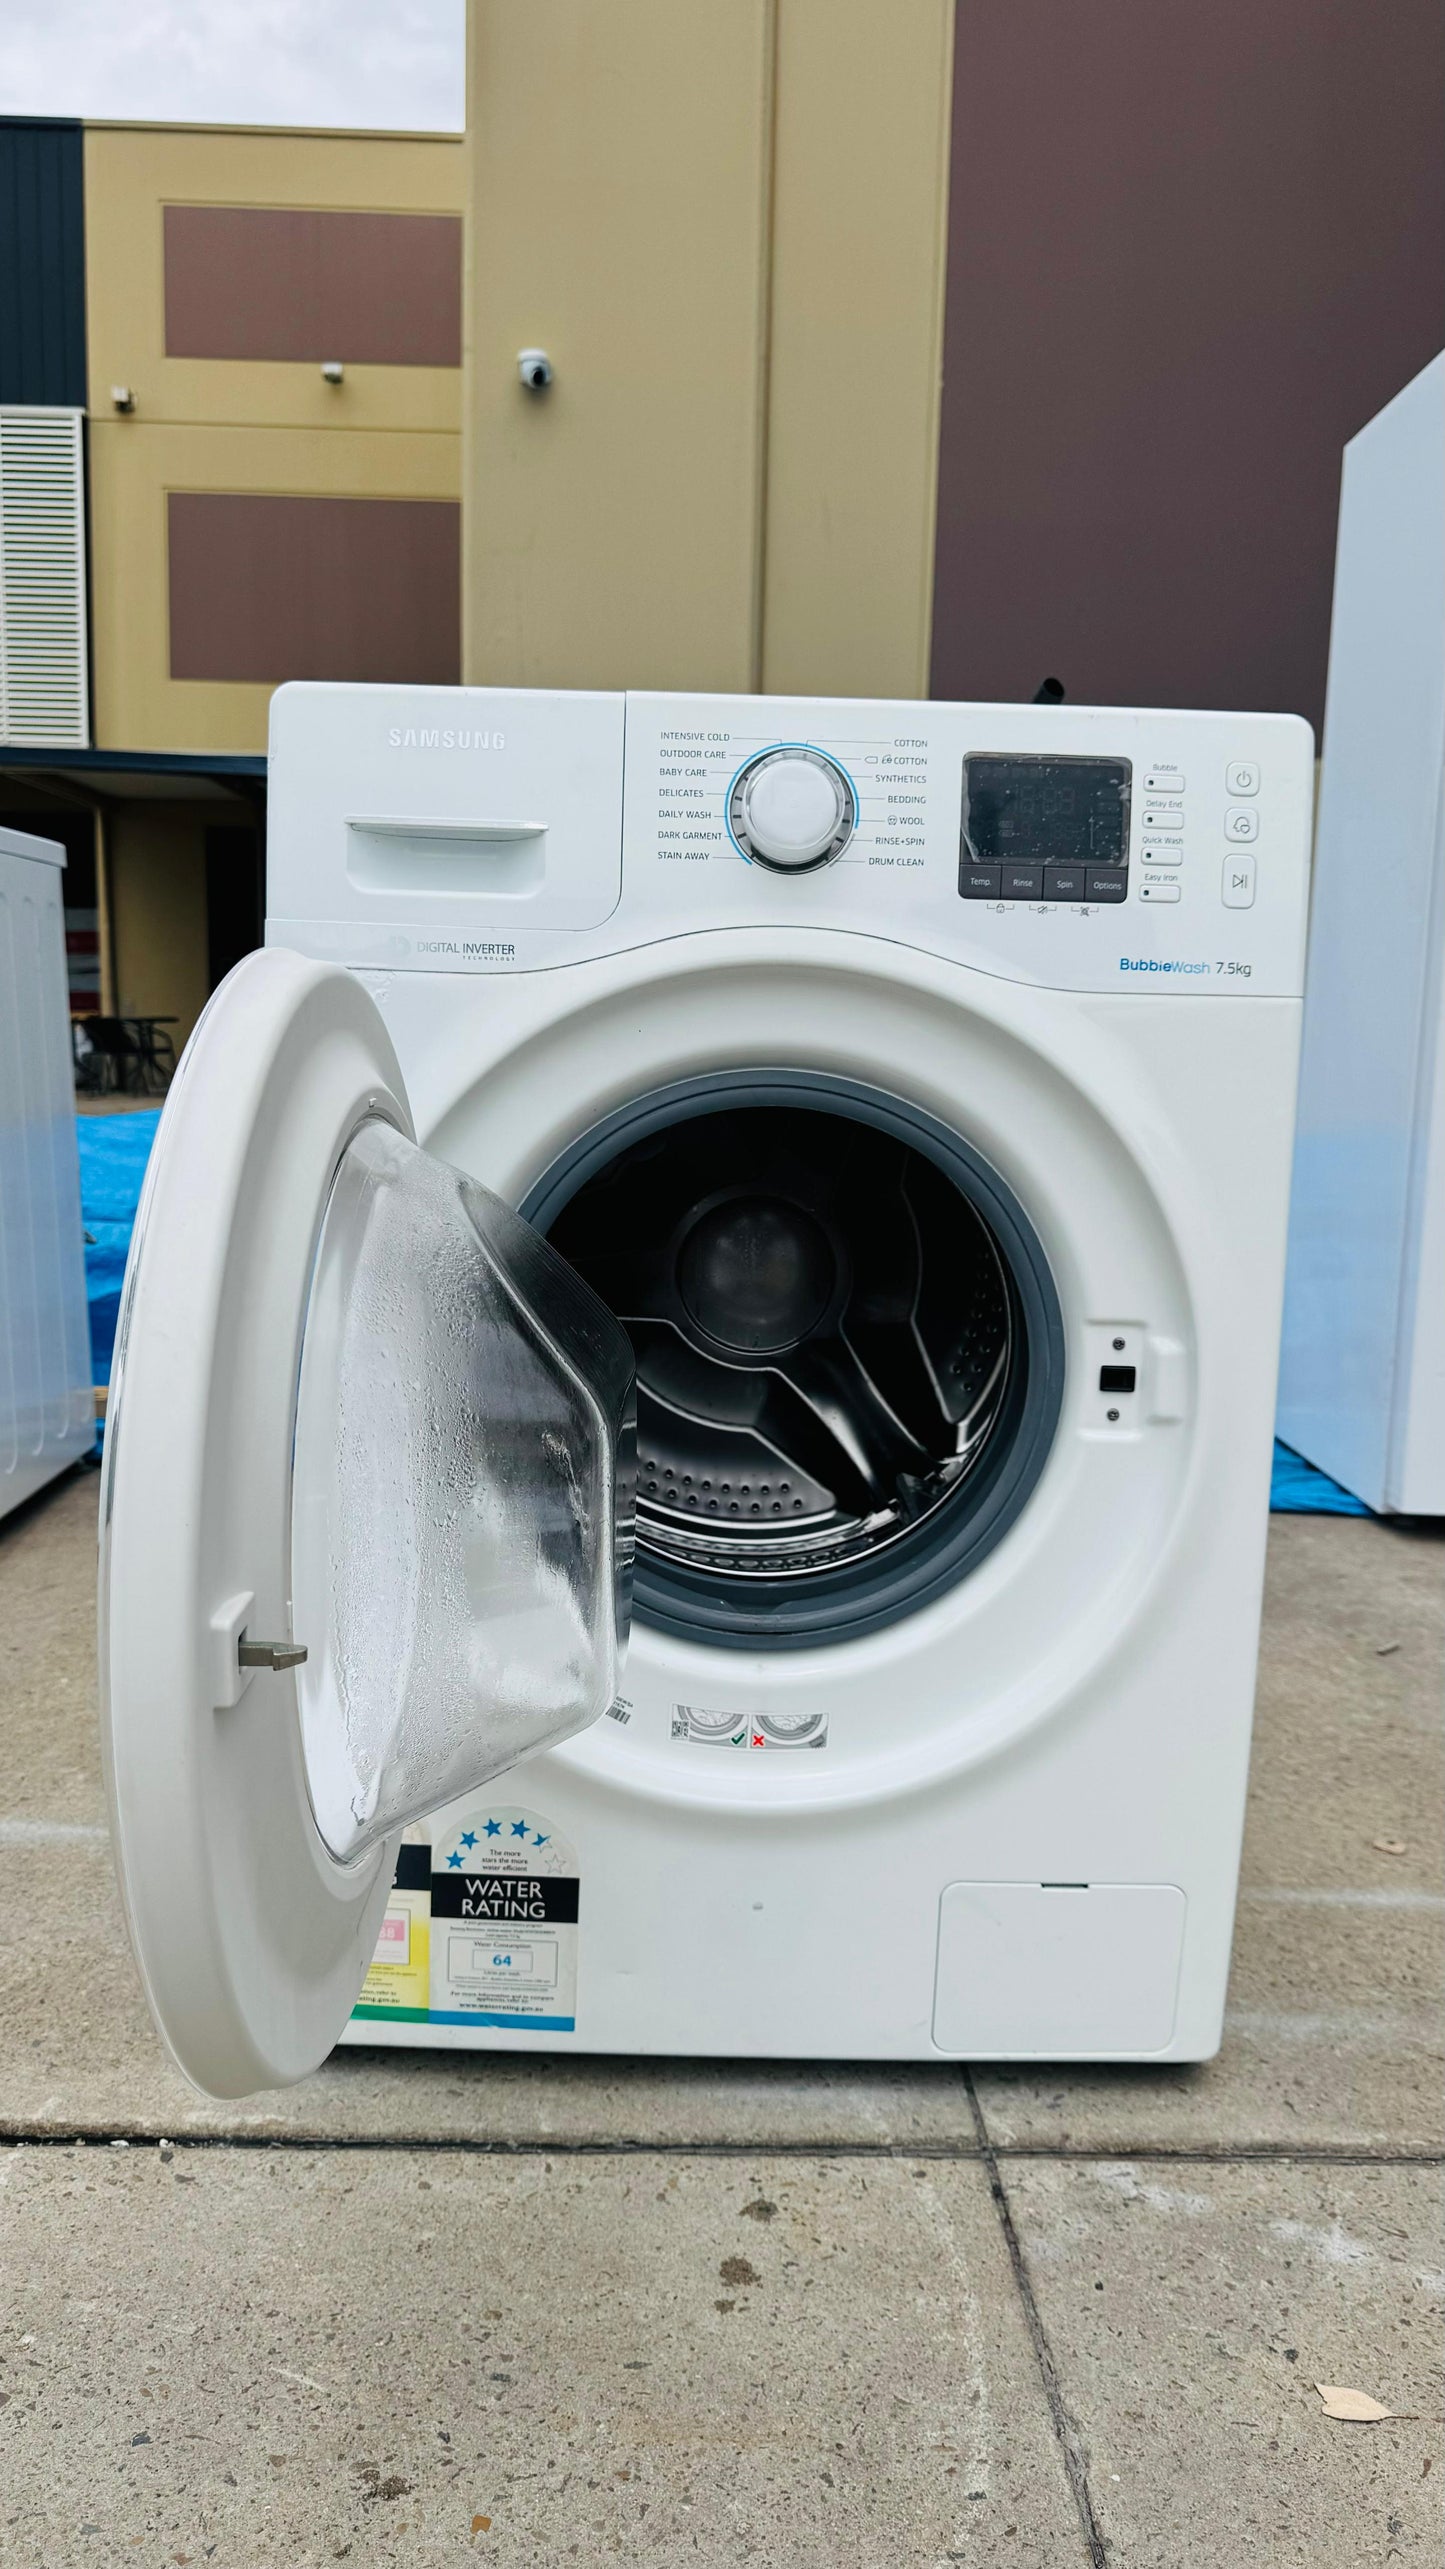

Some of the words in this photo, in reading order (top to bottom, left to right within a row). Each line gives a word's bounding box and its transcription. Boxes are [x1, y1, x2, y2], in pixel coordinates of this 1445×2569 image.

[388, 728, 505, 750] SAMSUNG
[660, 732, 705, 741] INTENSIVE
[707, 733, 730, 741] COLD
[894, 739, 928, 748] COTTON
[660, 749, 702, 758] OUTDOOR
[704, 750, 726, 759] CARE
[894, 757, 928, 765] COTTON
[1152, 763, 1178, 772] Bubble
[659, 768, 682, 776] BABY
[685, 768, 707, 777] CARE
[875, 774, 927, 784] SYNTHETICS
[659, 788, 704, 797] DELICATES
[888, 795, 927, 804] BEDDING
[1146, 800, 1167, 808] Delay
[1168, 800, 1182, 808] End
[658, 810, 683, 818] DAILY
[686, 811, 712, 819] WASH
[899, 817, 925, 826] WOOL
[658, 831, 680, 839] DARK
[683, 832, 722, 840] GARMENT
[1142, 836, 1162, 846] Quick
[1164, 837, 1183, 845] Wash
[657, 851, 682, 859] STAIN
[684, 852, 710, 860] AWAY
[869, 857, 895, 866] DRUM
[896, 858, 925, 866] CLEAN
[970, 877, 992, 887] Temp.
[1144, 873, 1161, 882] Easy
[1013, 879, 1033, 888] Rinse
[1056, 879, 1074, 889] Spin
[1093, 881, 1122, 891] Options
[417, 941, 460, 953] DIGITAL
[463, 943, 515, 955] INVERTER
[1216, 962, 1251, 977] 7.5kg
[490, 1848, 501, 1856] The
[465, 1878, 543, 1899] WATER
[461, 1898, 546, 1918] RATING
[493, 1954, 512, 1967] 64
